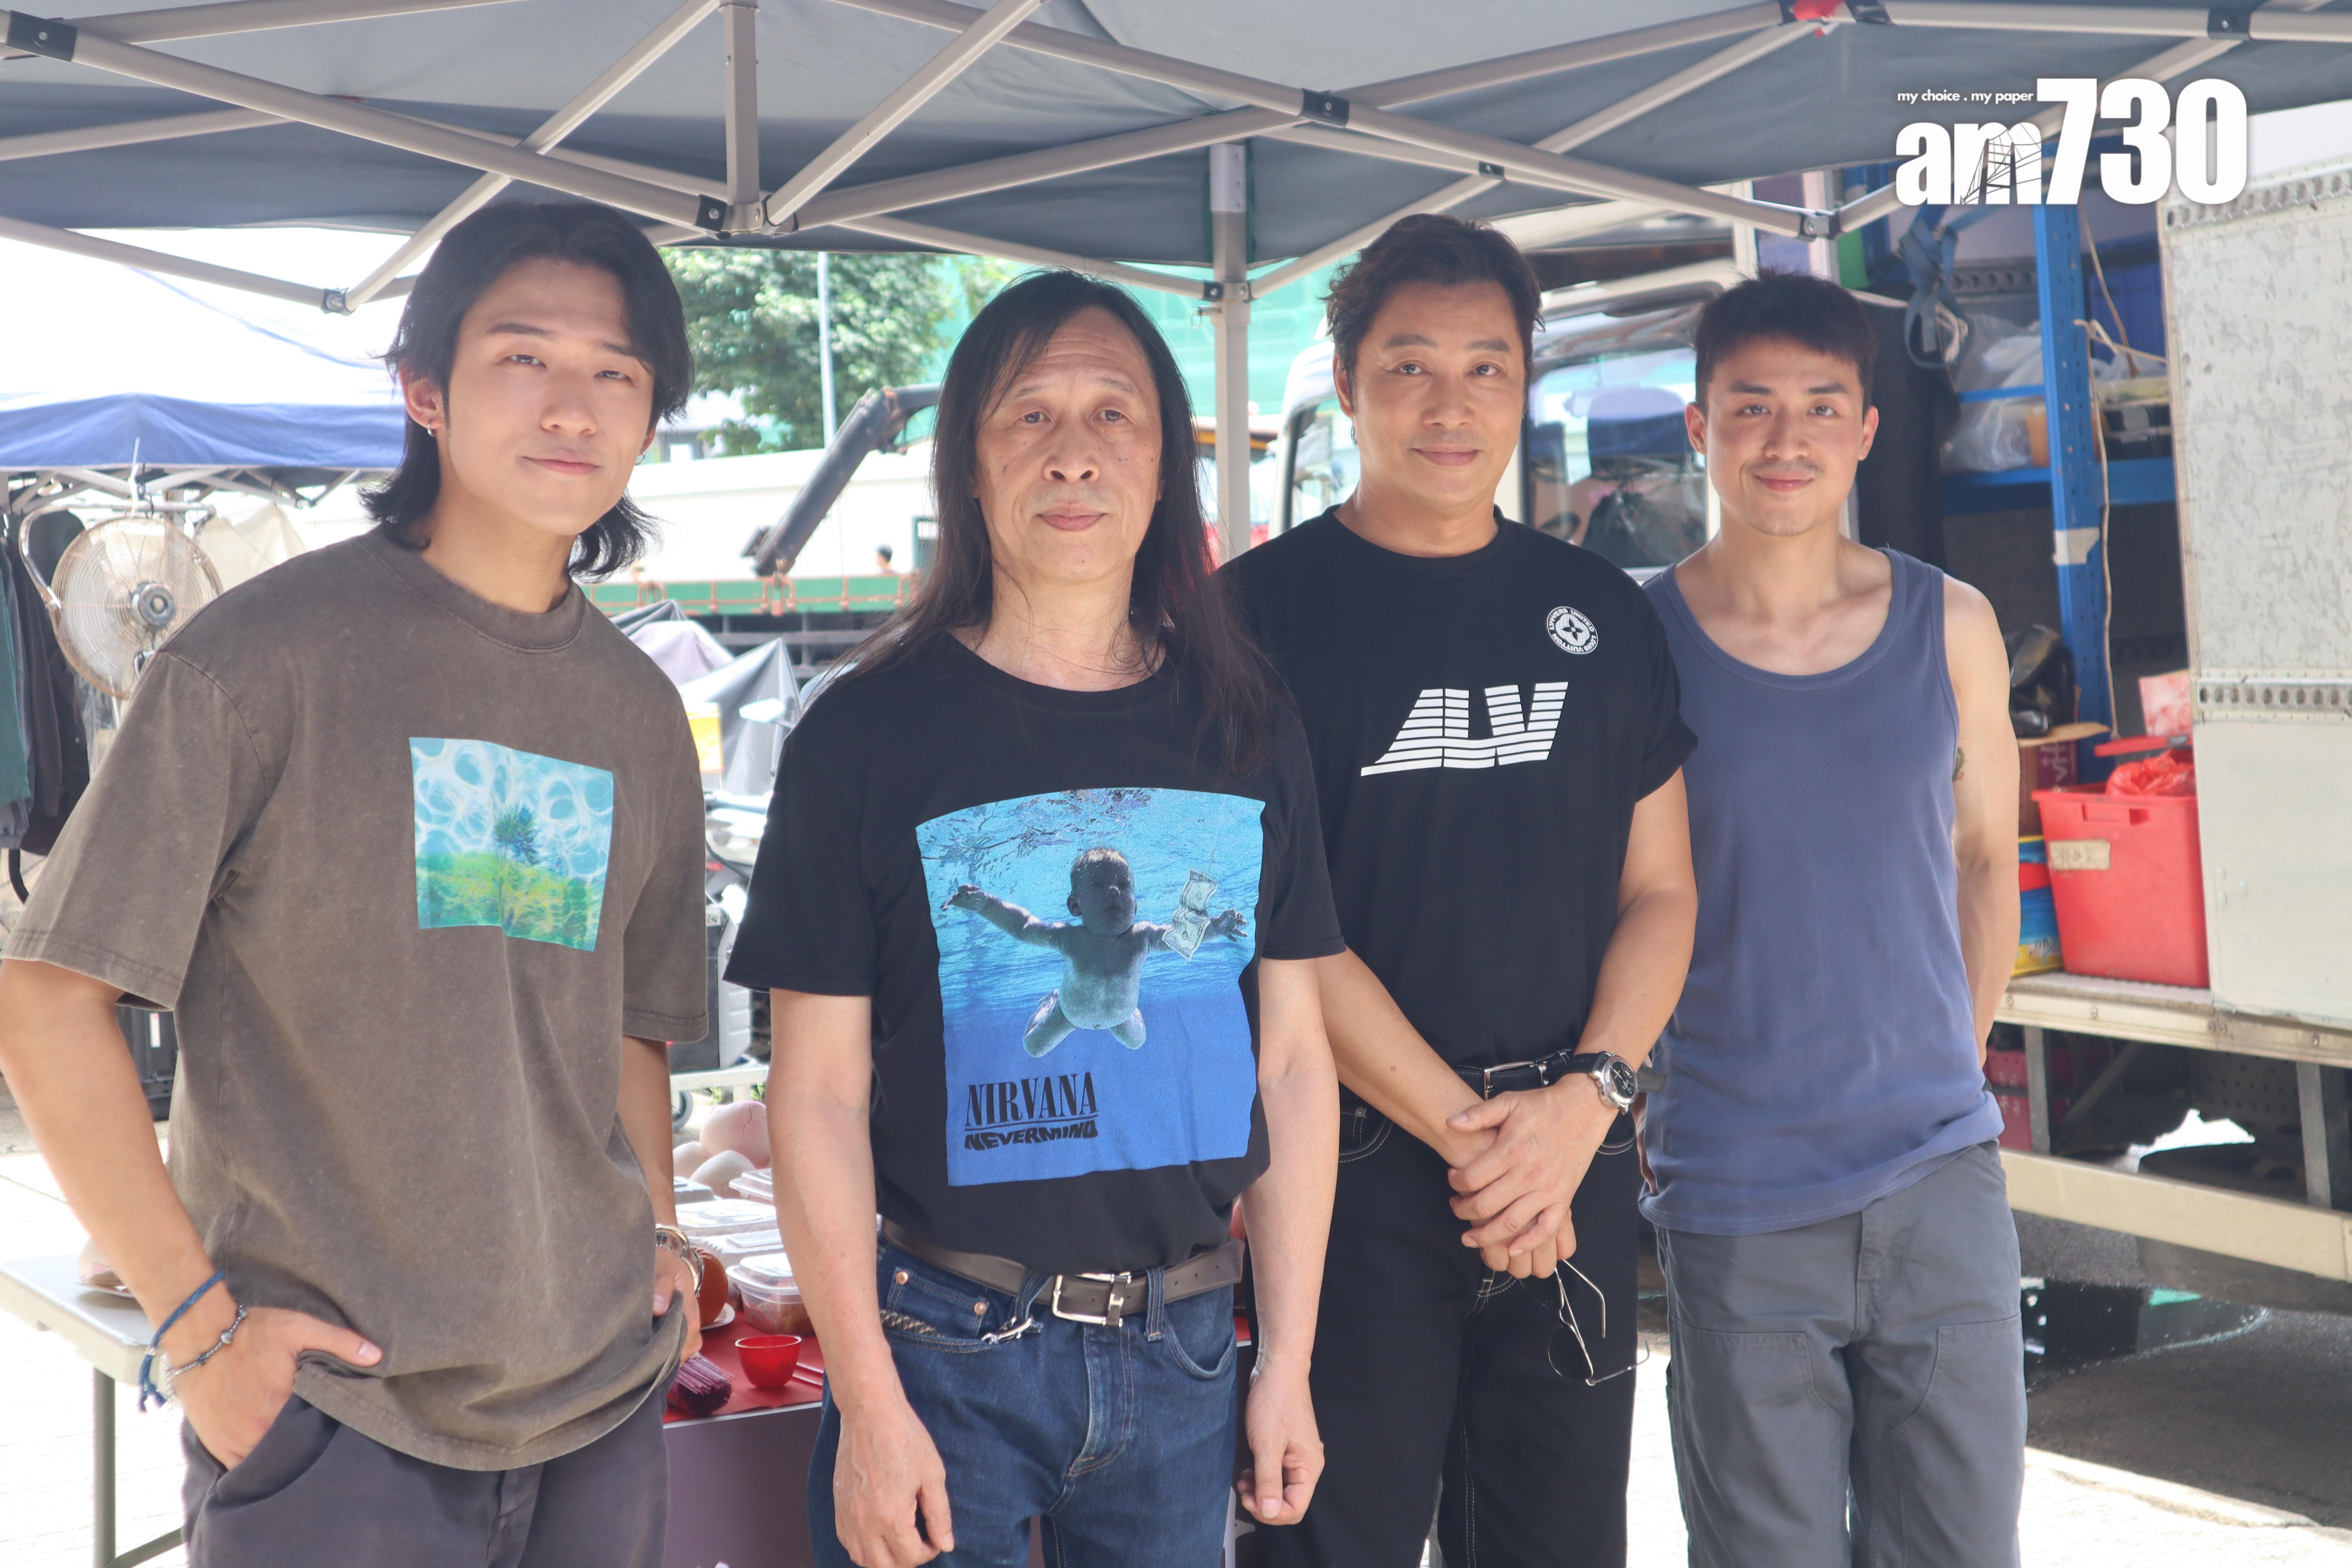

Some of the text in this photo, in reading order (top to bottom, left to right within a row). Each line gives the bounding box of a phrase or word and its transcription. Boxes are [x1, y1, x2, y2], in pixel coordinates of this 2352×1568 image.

[1571, 609, 1595, 632] UNITED
[1552, 633, 1597, 652] LOUIS VUITTON
[964, 1072, 1098, 1127] NIRVANA
[964, 1120, 1098, 1151] NEVERMIND
